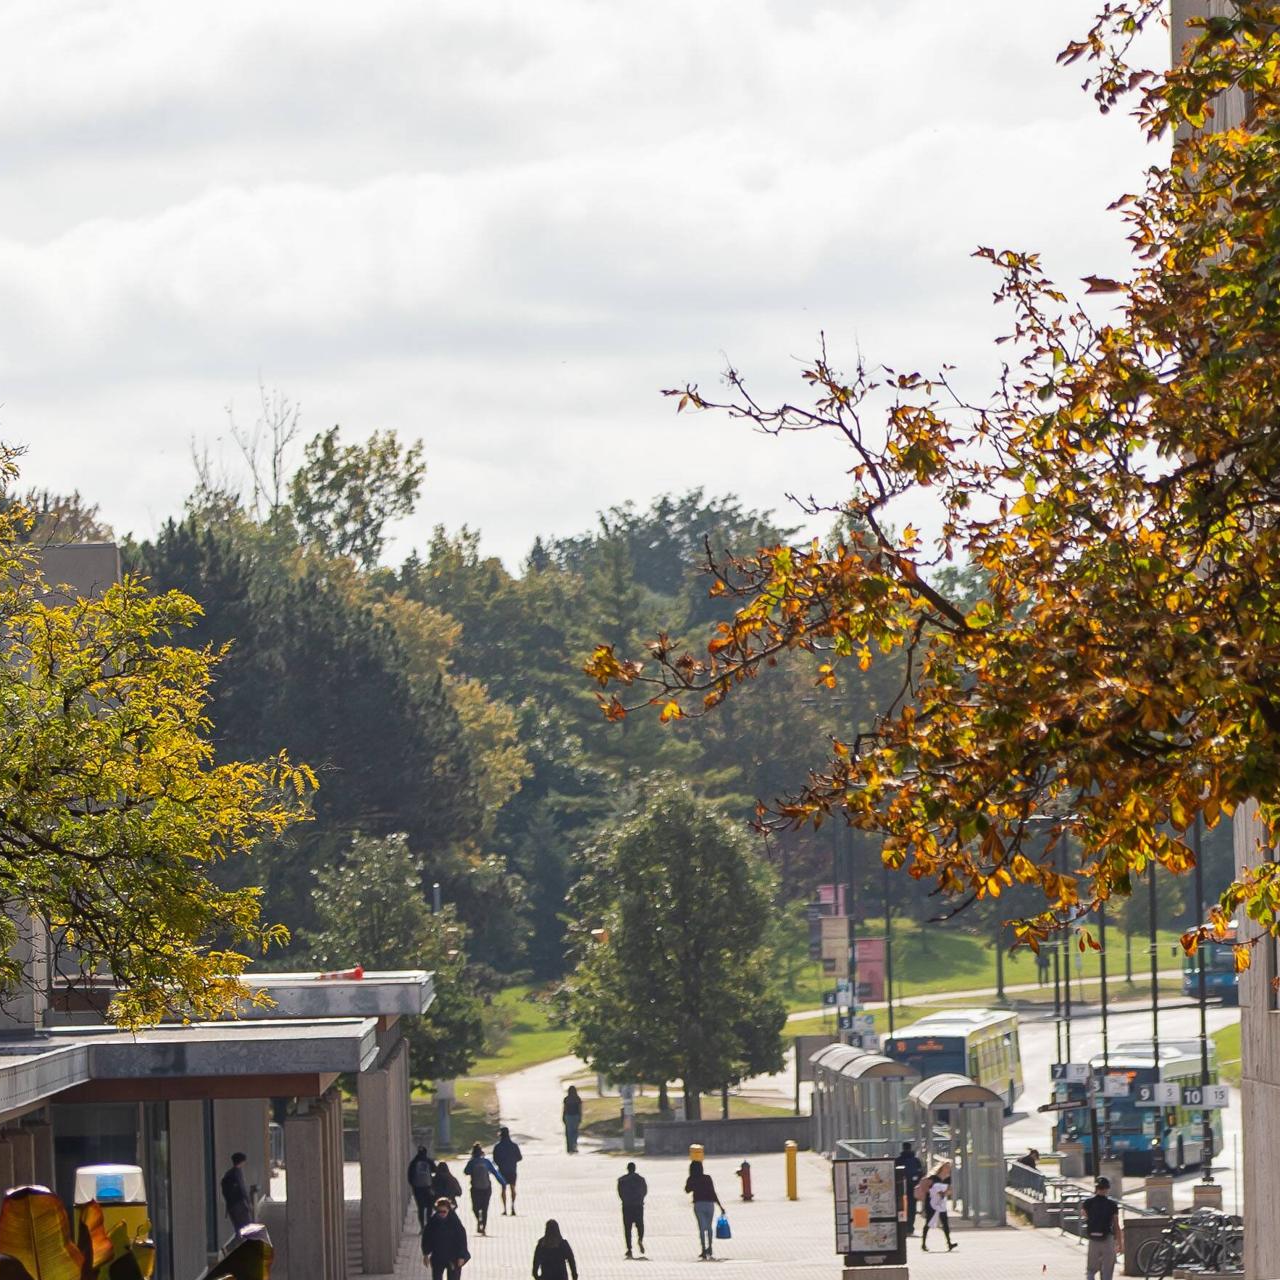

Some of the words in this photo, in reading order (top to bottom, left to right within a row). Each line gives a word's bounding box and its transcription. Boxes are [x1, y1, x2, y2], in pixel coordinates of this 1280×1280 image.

[1054, 1067, 1063, 1078] 7
[1140, 1088, 1150, 1100] 9
[1184, 1091, 1202, 1103] 10
